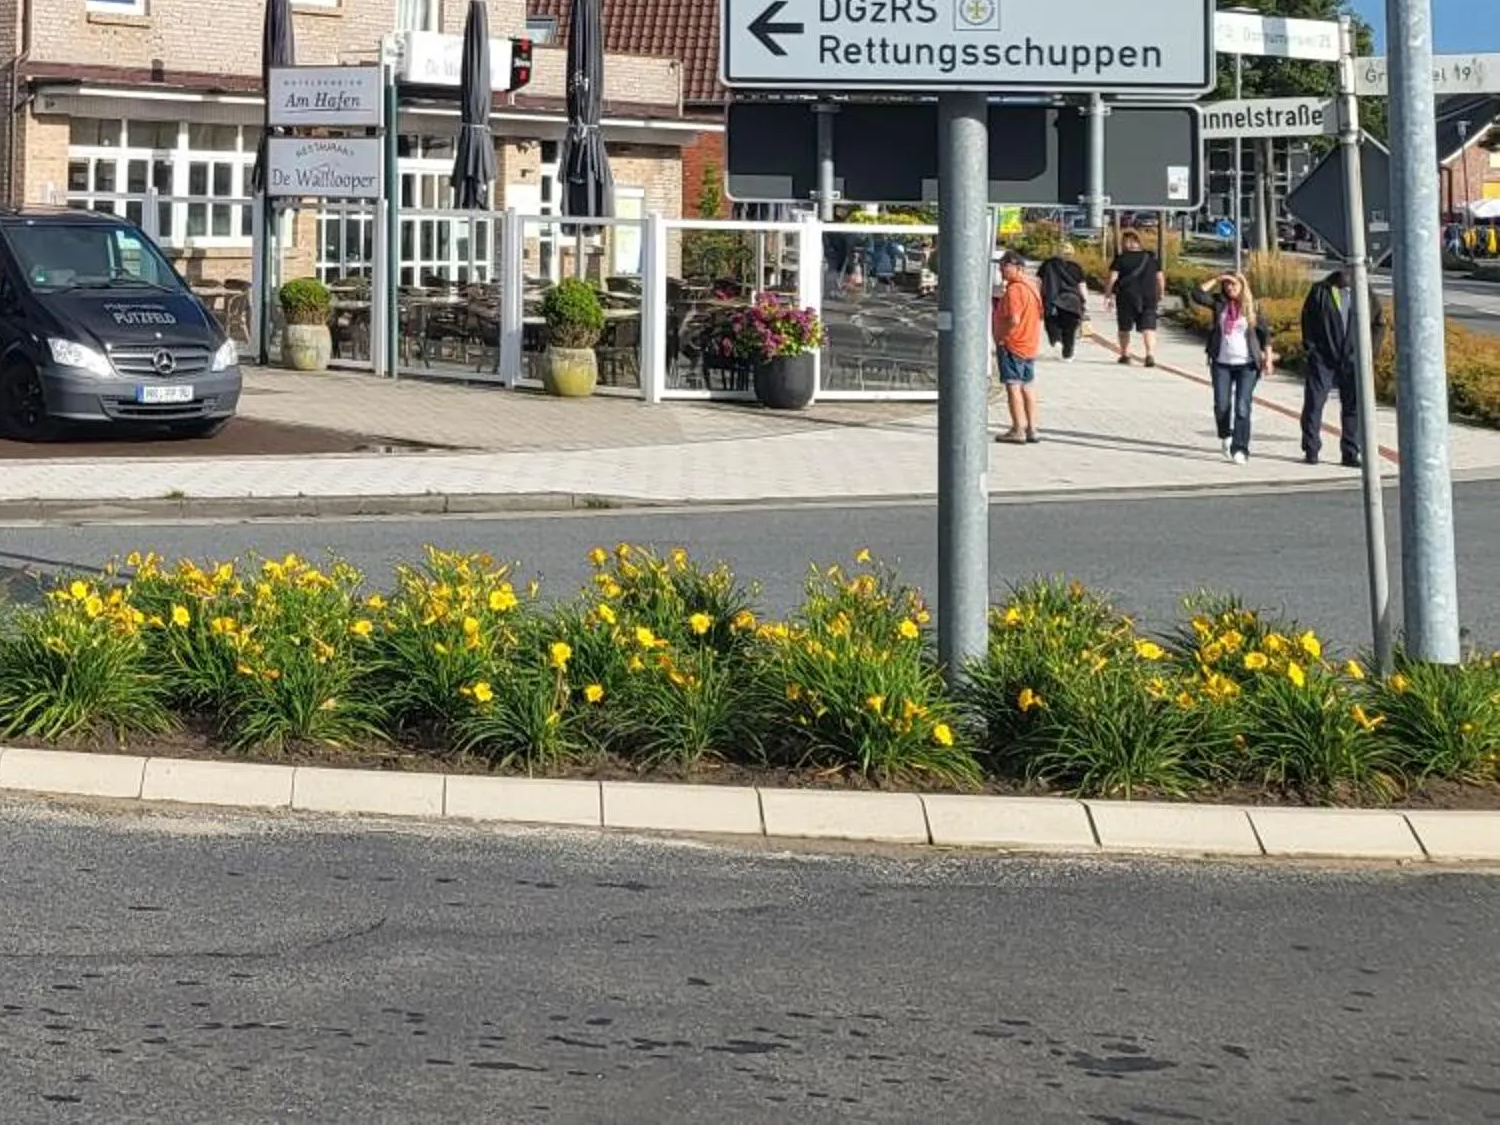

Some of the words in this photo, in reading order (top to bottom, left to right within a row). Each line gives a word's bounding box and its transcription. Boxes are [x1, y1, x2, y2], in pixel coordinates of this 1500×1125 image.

[819, 35, 1161, 74] Rettungsschuppen
[284, 92, 310, 108] Am
[314, 91, 361, 111] Hafen
[1203, 104, 1323, 129] nnelstraße
[272, 168, 290, 186] De
